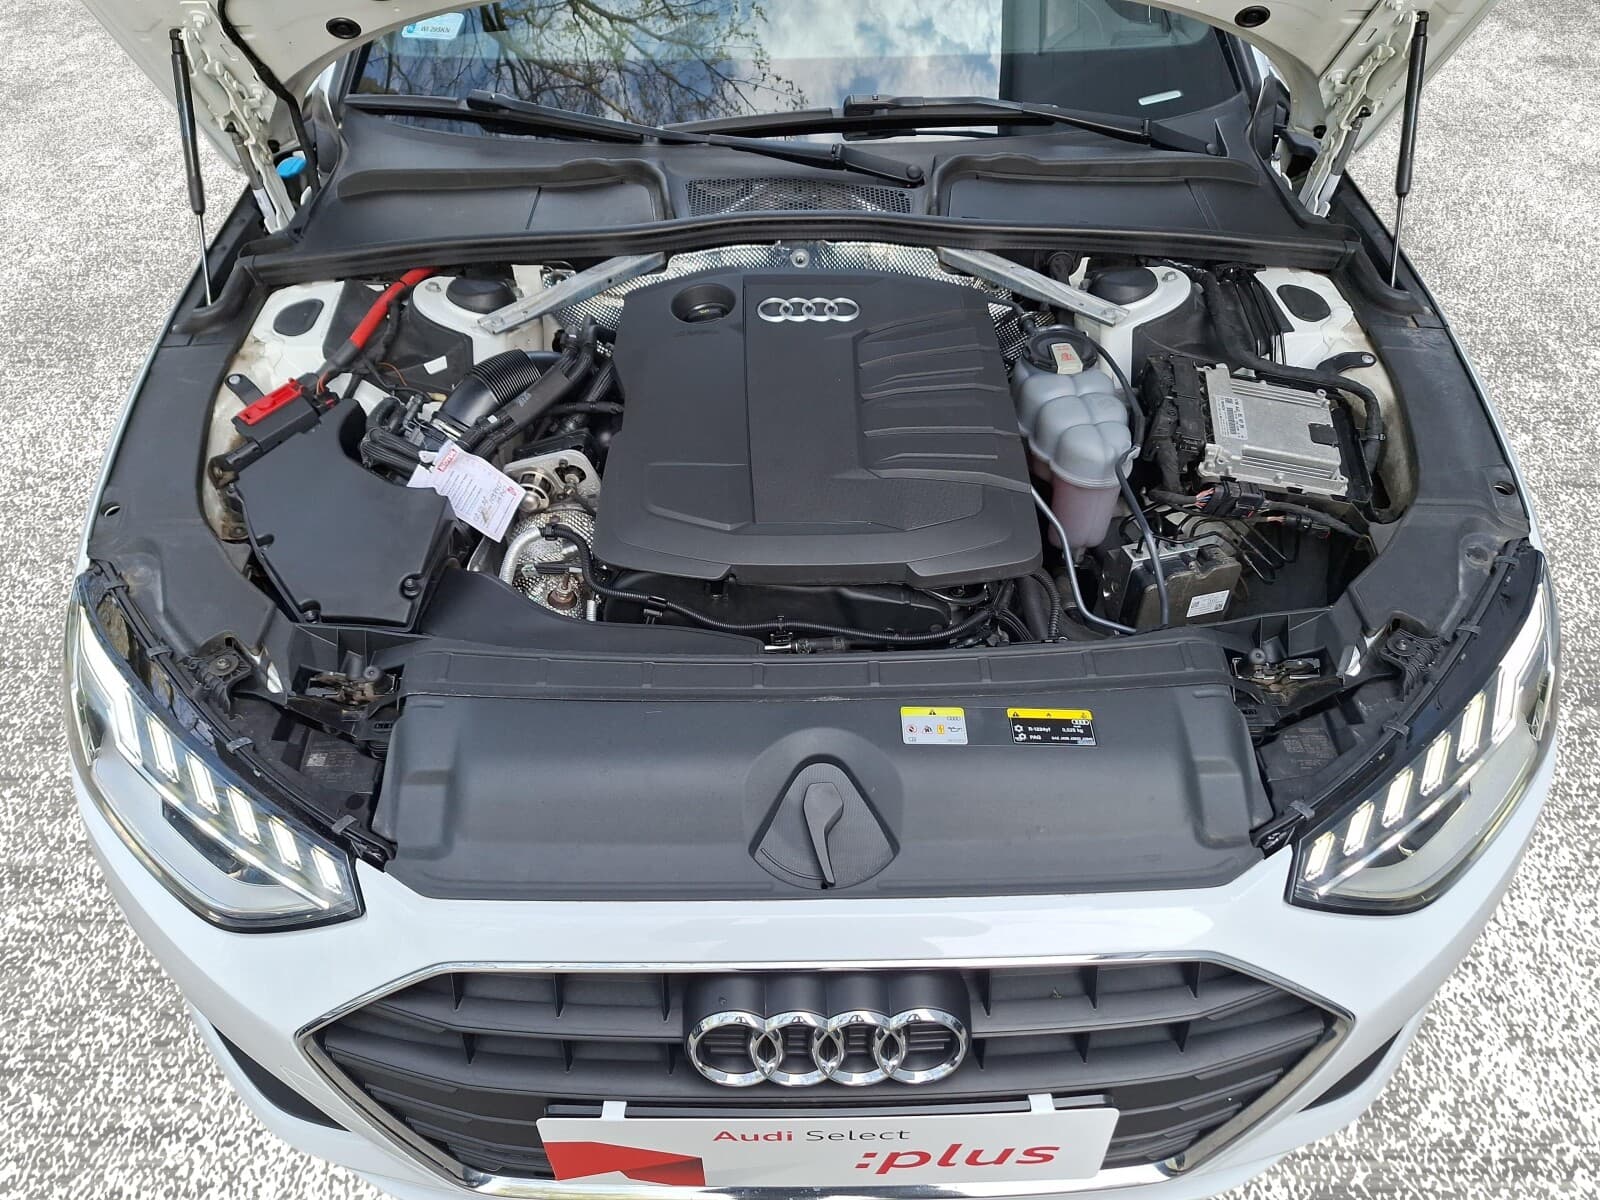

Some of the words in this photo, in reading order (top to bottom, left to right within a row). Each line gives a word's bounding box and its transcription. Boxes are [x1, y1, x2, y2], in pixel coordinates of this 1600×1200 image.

[713, 1130, 793, 1142] Audi
[805, 1129, 912, 1142] Select
[855, 1143, 1061, 1175] :plus
